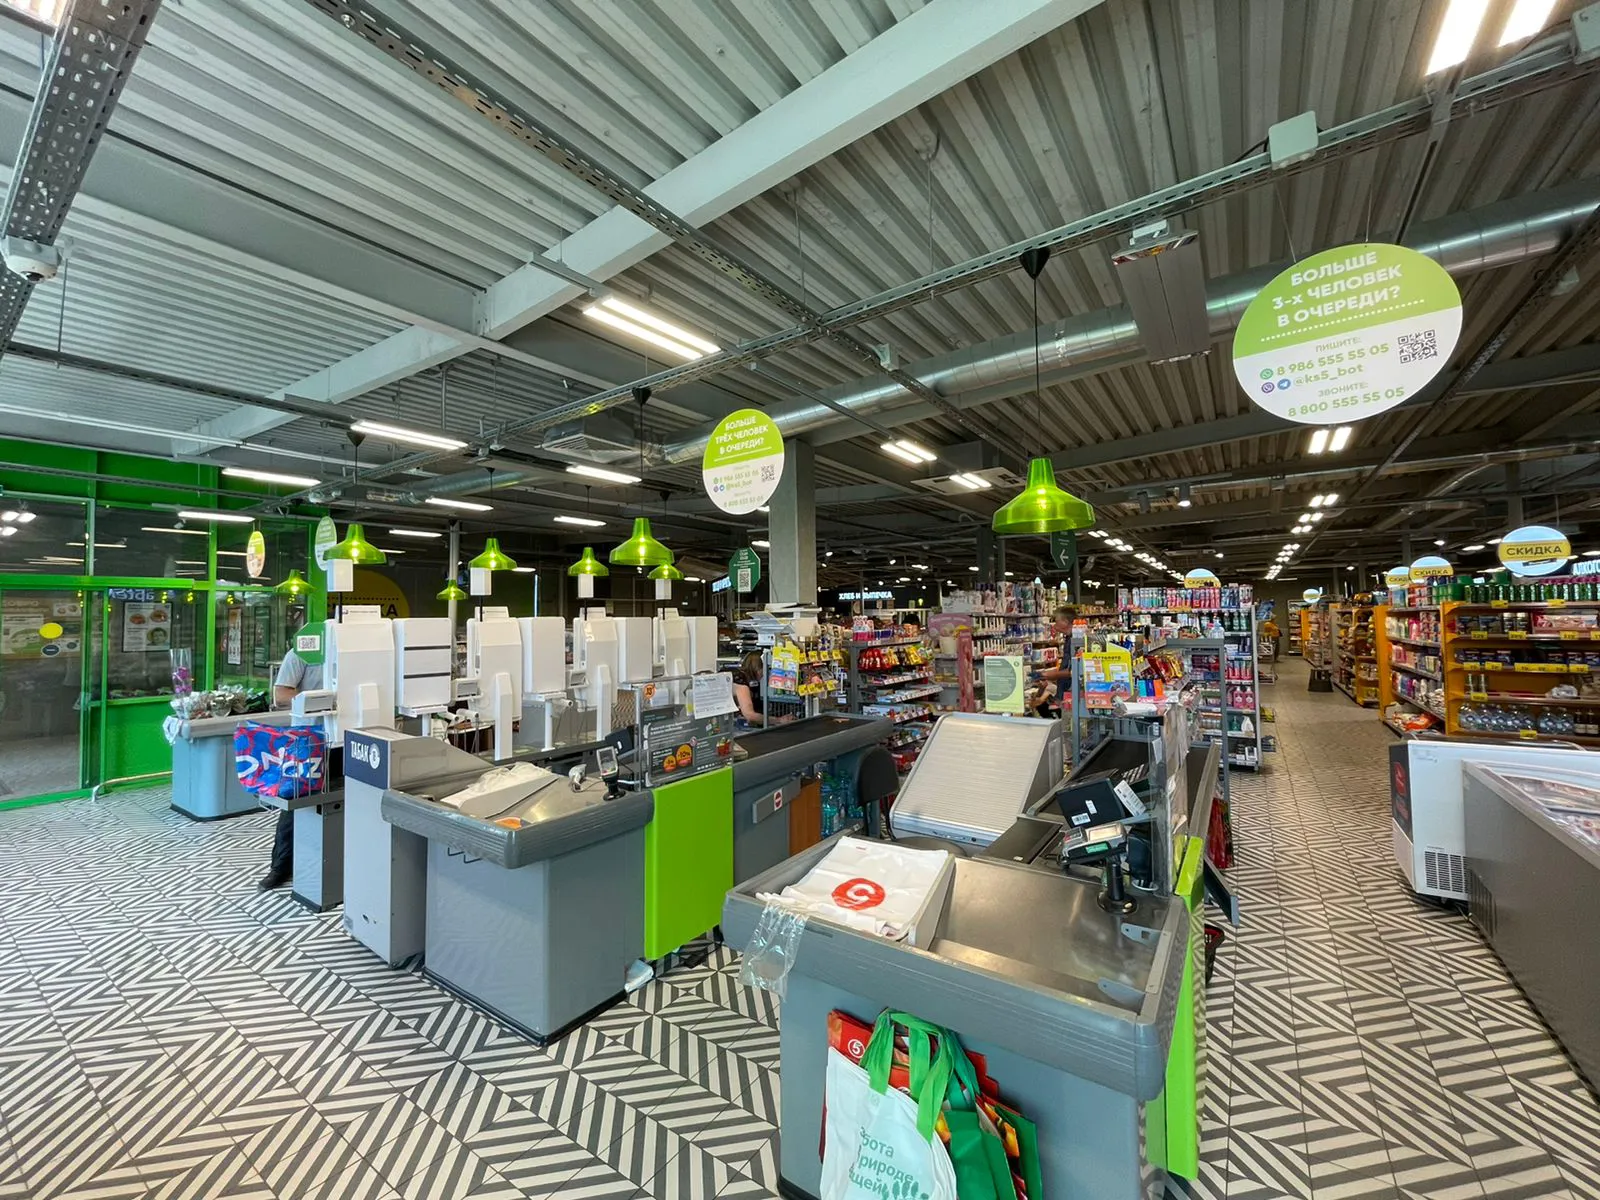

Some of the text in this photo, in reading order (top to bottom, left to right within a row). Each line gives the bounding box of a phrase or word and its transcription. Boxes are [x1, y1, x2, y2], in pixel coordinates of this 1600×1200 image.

[1291, 252, 1377, 287] БОЛЬШЕ
[1307, 264, 1402, 301] ЧЕЛОВЕК
[1277, 285, 1401, 328] В ОЧЕРЕДИ?
[1277, 343, 1389, 376] 8 986 555 55 05
[1288, 386, 1405, 417] 8 800 555 55 05
[726, 416, 756, 430] БОЛЬШЕ
[734, 424, 768, 439] ЧЕЛОВЕК
[1506, 546, 1562, 556] СКИДКА
[350, 741, 369, 762] ТАБАК
[861, 1130, 894, 1158] бота
[857, 1153, 914, 1184] рироде
